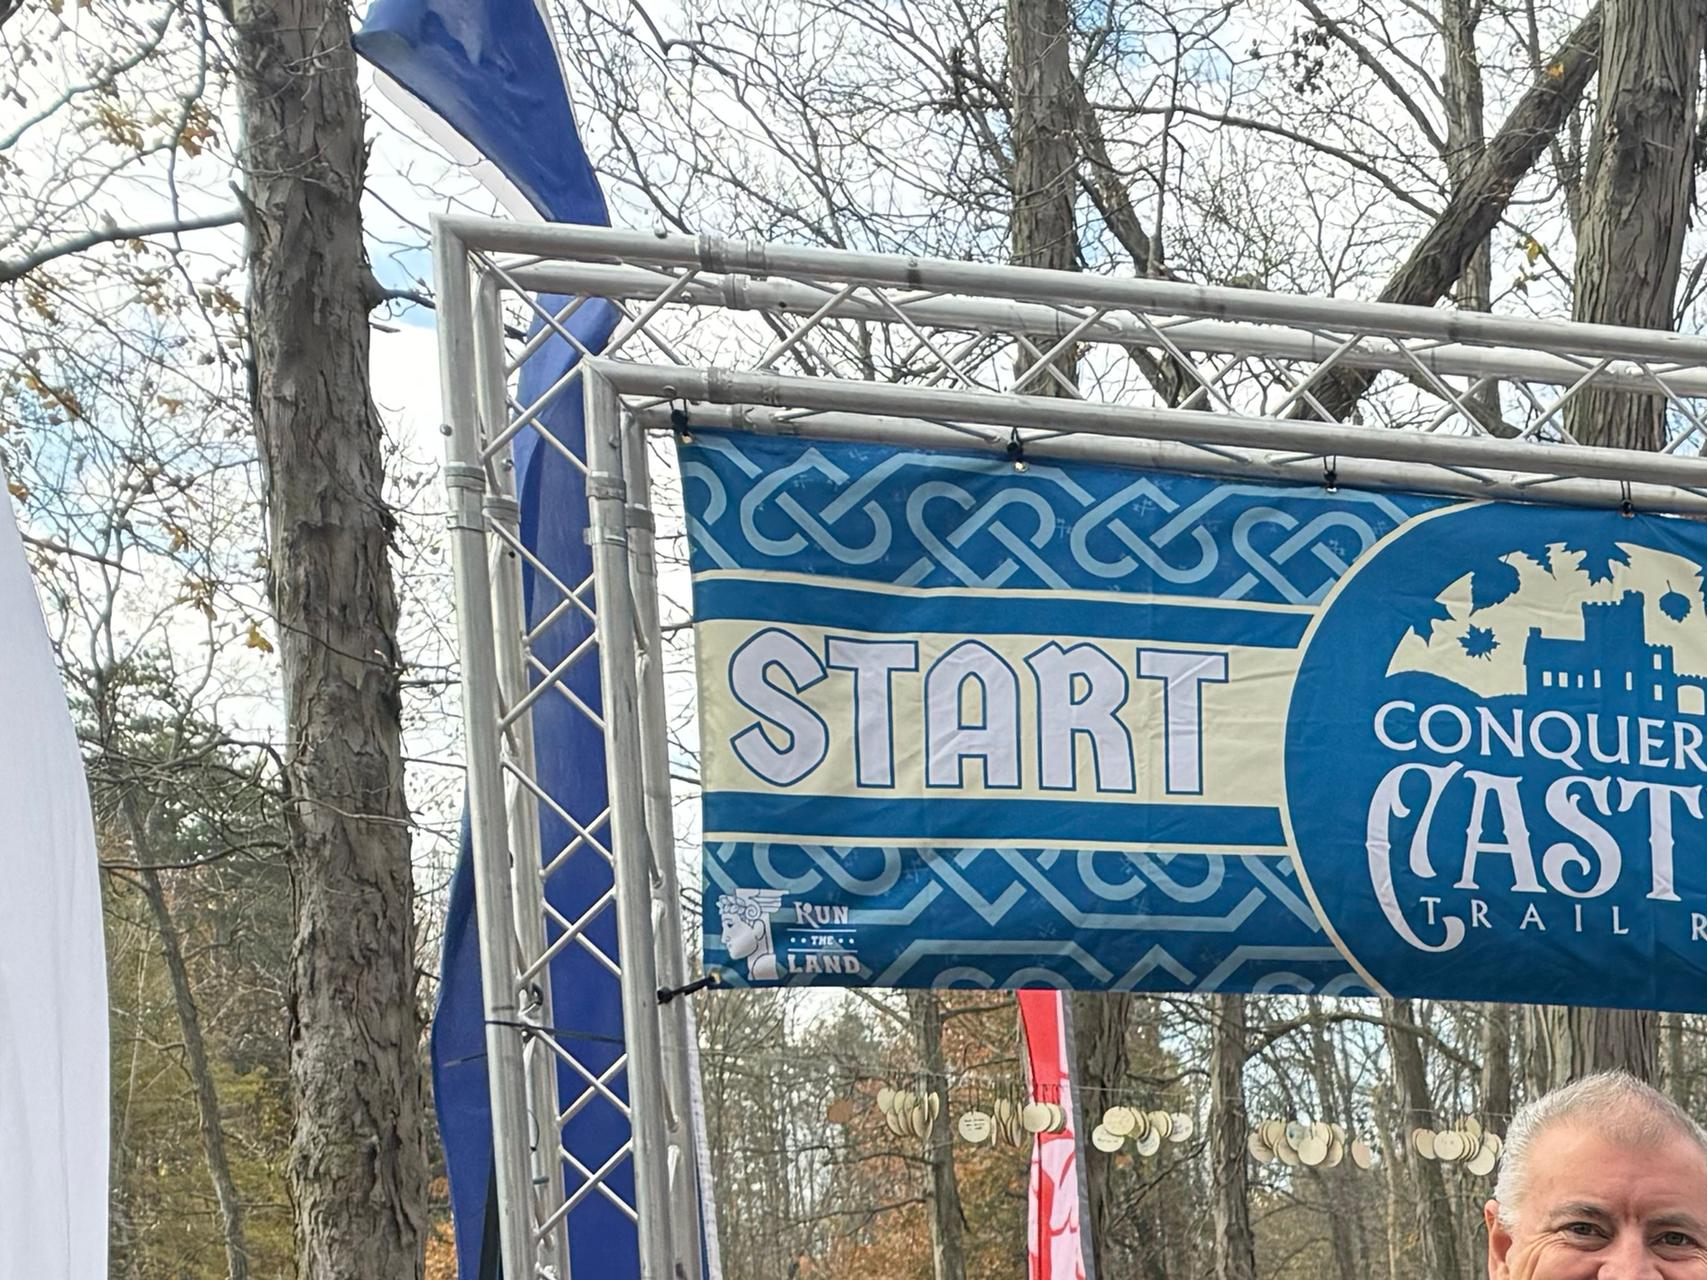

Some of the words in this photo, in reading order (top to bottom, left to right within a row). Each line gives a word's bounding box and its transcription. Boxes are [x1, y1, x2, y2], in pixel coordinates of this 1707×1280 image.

[729, 626, 1229, 796] START
[793, 901, 849, 929] RUN
[1419, 896, 1630, 936] TRAIL
[811, 936, 834, 946] THE
[787, 953, 861, 974] LAND
